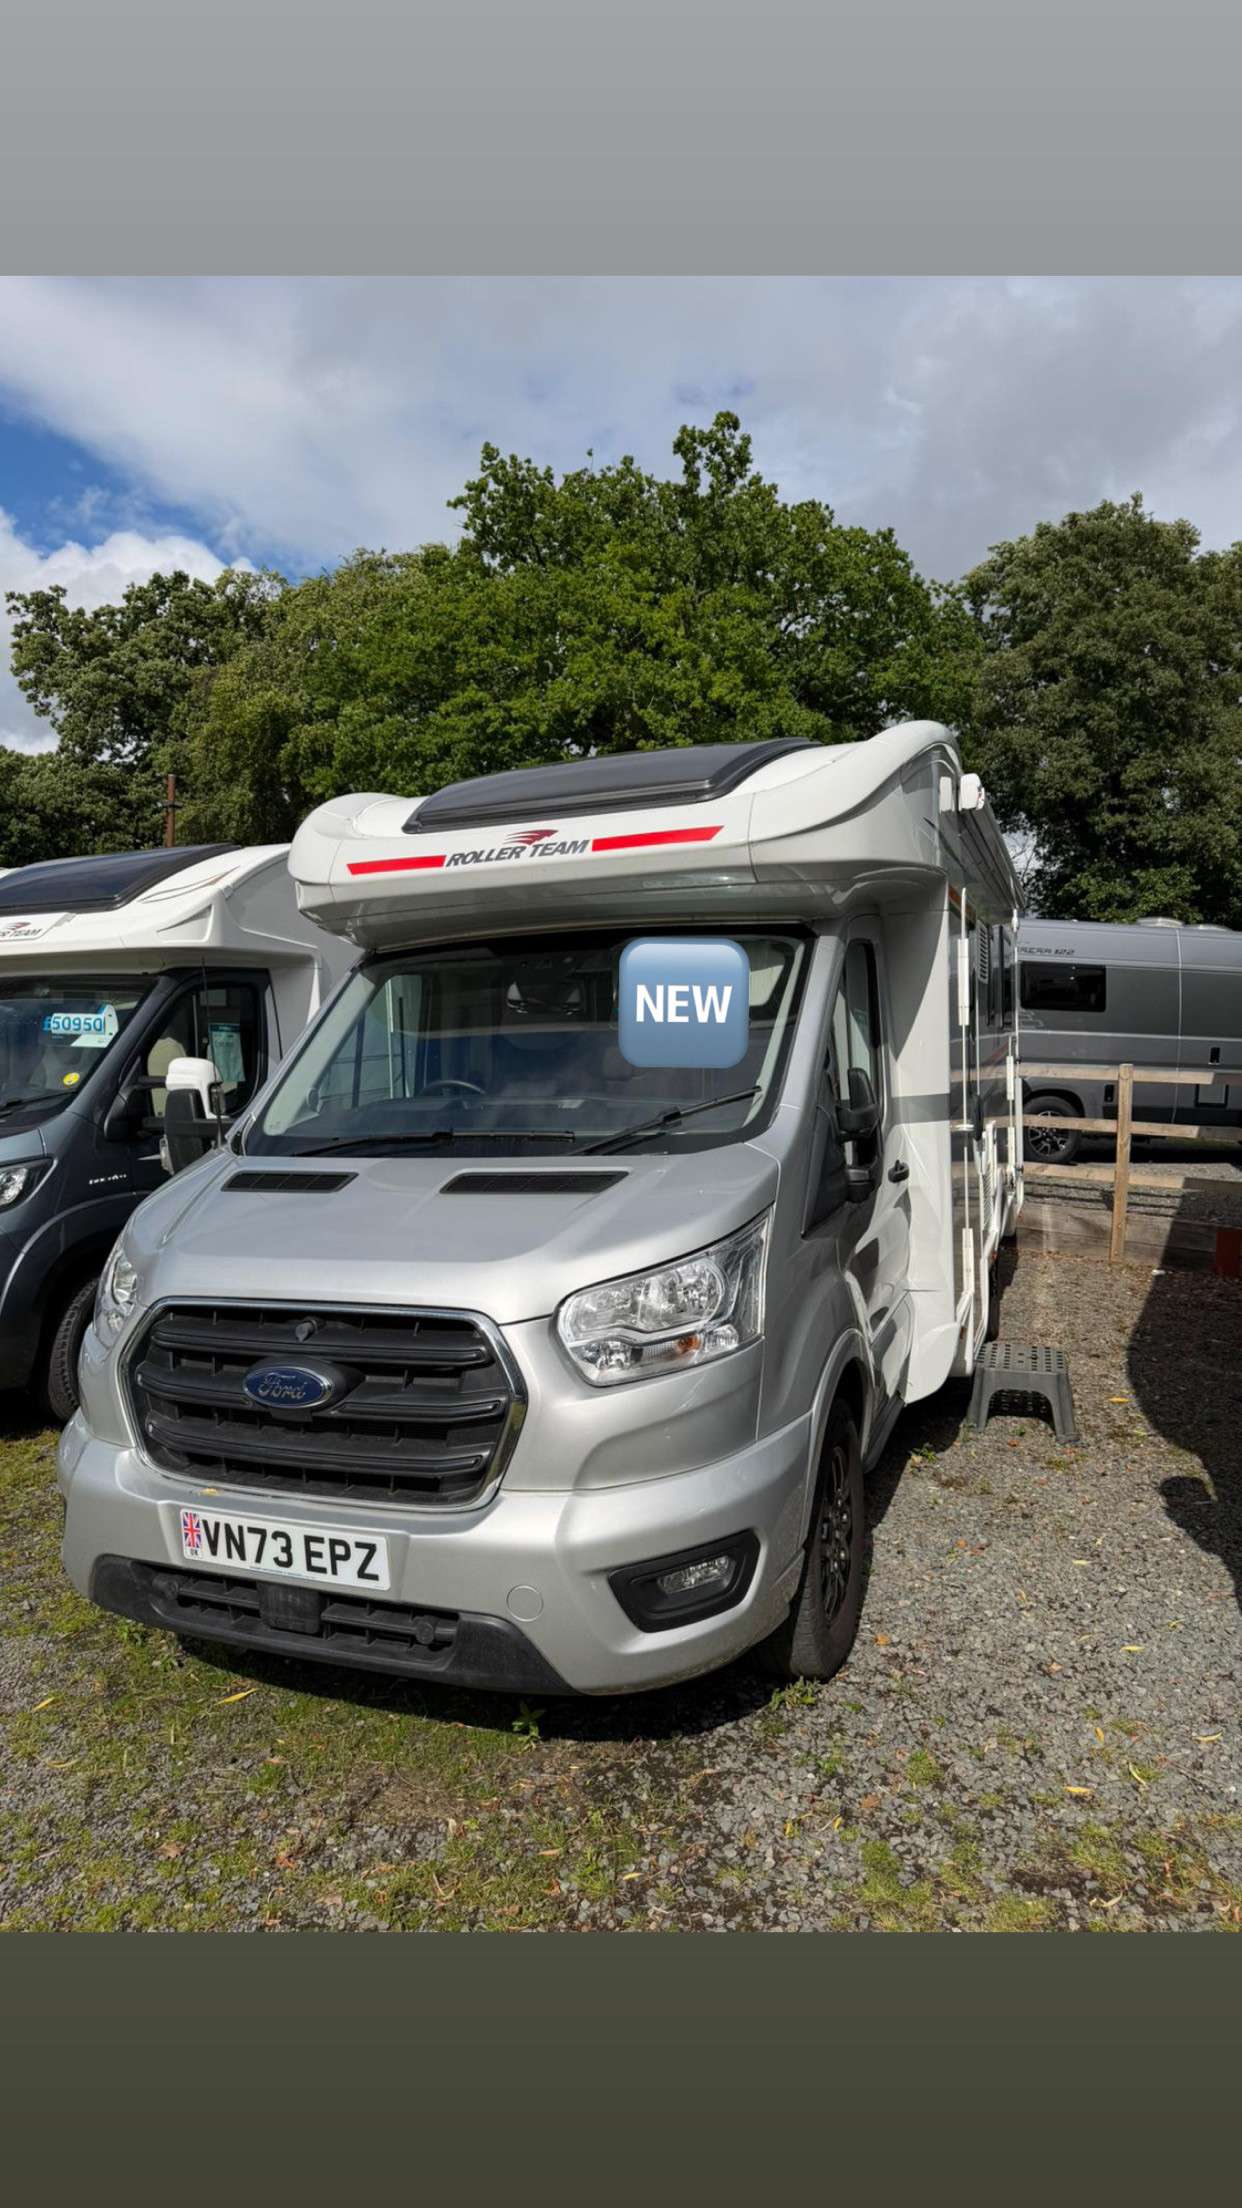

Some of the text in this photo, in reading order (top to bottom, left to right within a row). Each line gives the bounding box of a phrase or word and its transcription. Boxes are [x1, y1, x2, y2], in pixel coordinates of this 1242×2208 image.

[445, 839, 590, 867] ROLLER TEAM
[258, 1372, 308, 1399] Ford
[202, 1519, 380, 1581] VN73 EPZ
